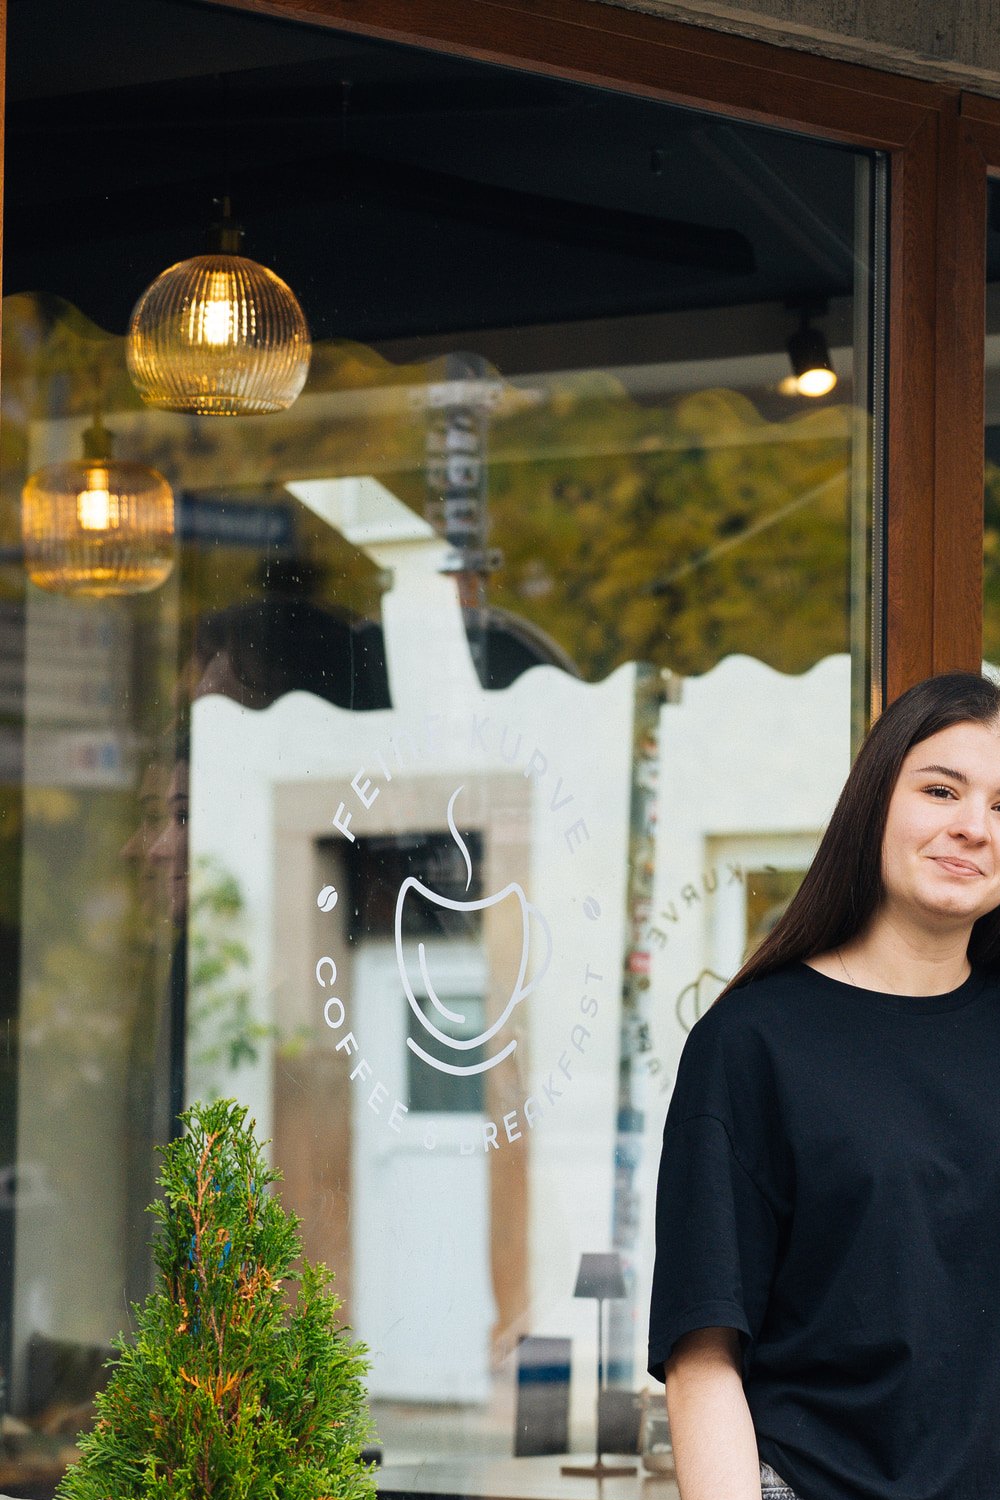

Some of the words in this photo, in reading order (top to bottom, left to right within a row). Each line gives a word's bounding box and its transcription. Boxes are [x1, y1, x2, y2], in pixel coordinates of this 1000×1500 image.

[470, 716, 590, 855] KURVE
[315, 956, 409, 1133] COFFEE
[459, 964, 604, 1156] BREAKFAST
